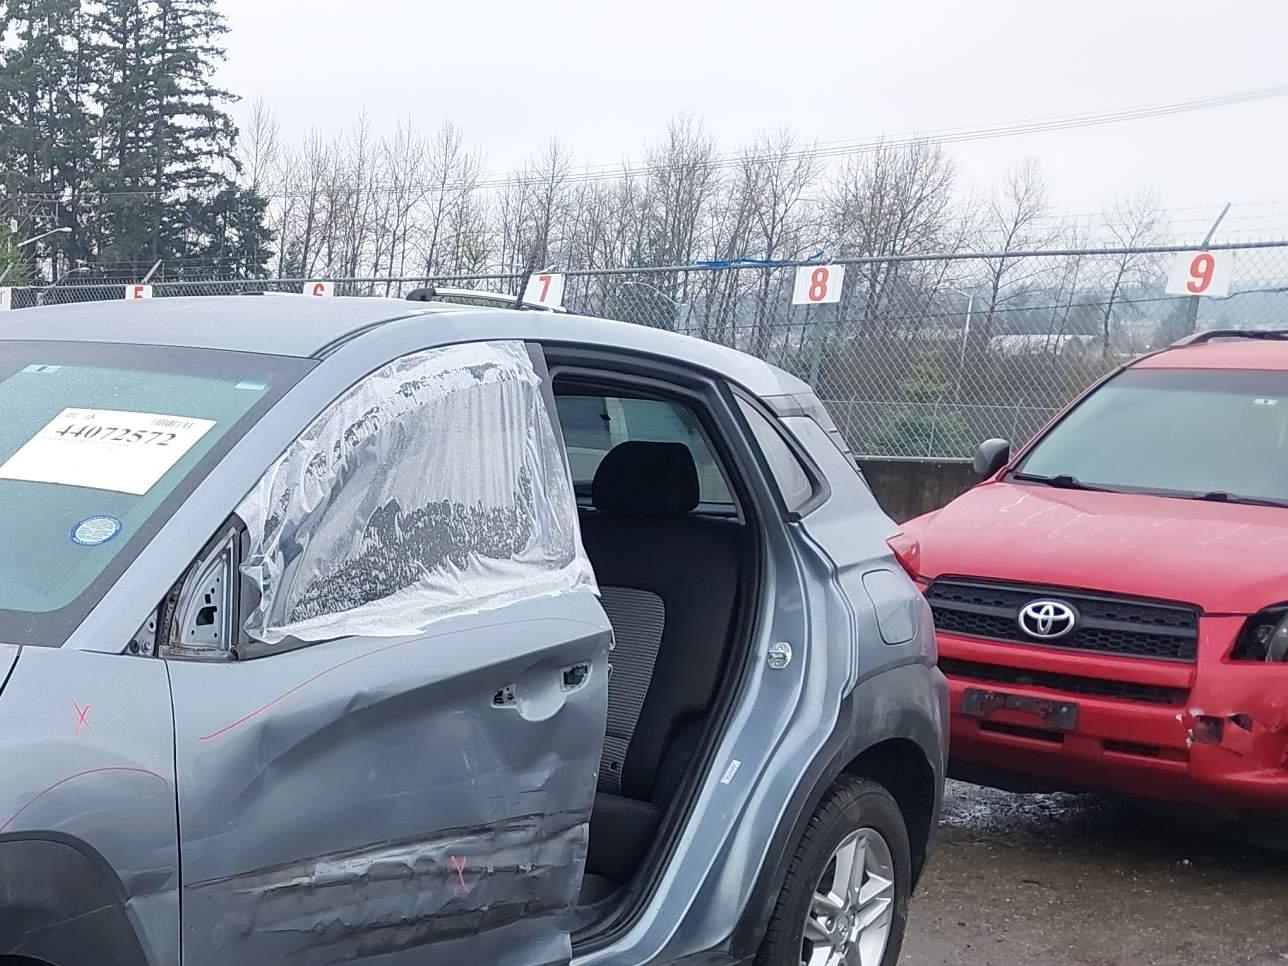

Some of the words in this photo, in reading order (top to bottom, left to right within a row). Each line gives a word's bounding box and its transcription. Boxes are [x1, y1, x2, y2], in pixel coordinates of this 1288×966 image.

[808, 267, 829, 301] 8
[1187, 253, 1215, 293] 9
[539, 275, 552, 302] 7
[55, 423, 177, 447] 44072572
